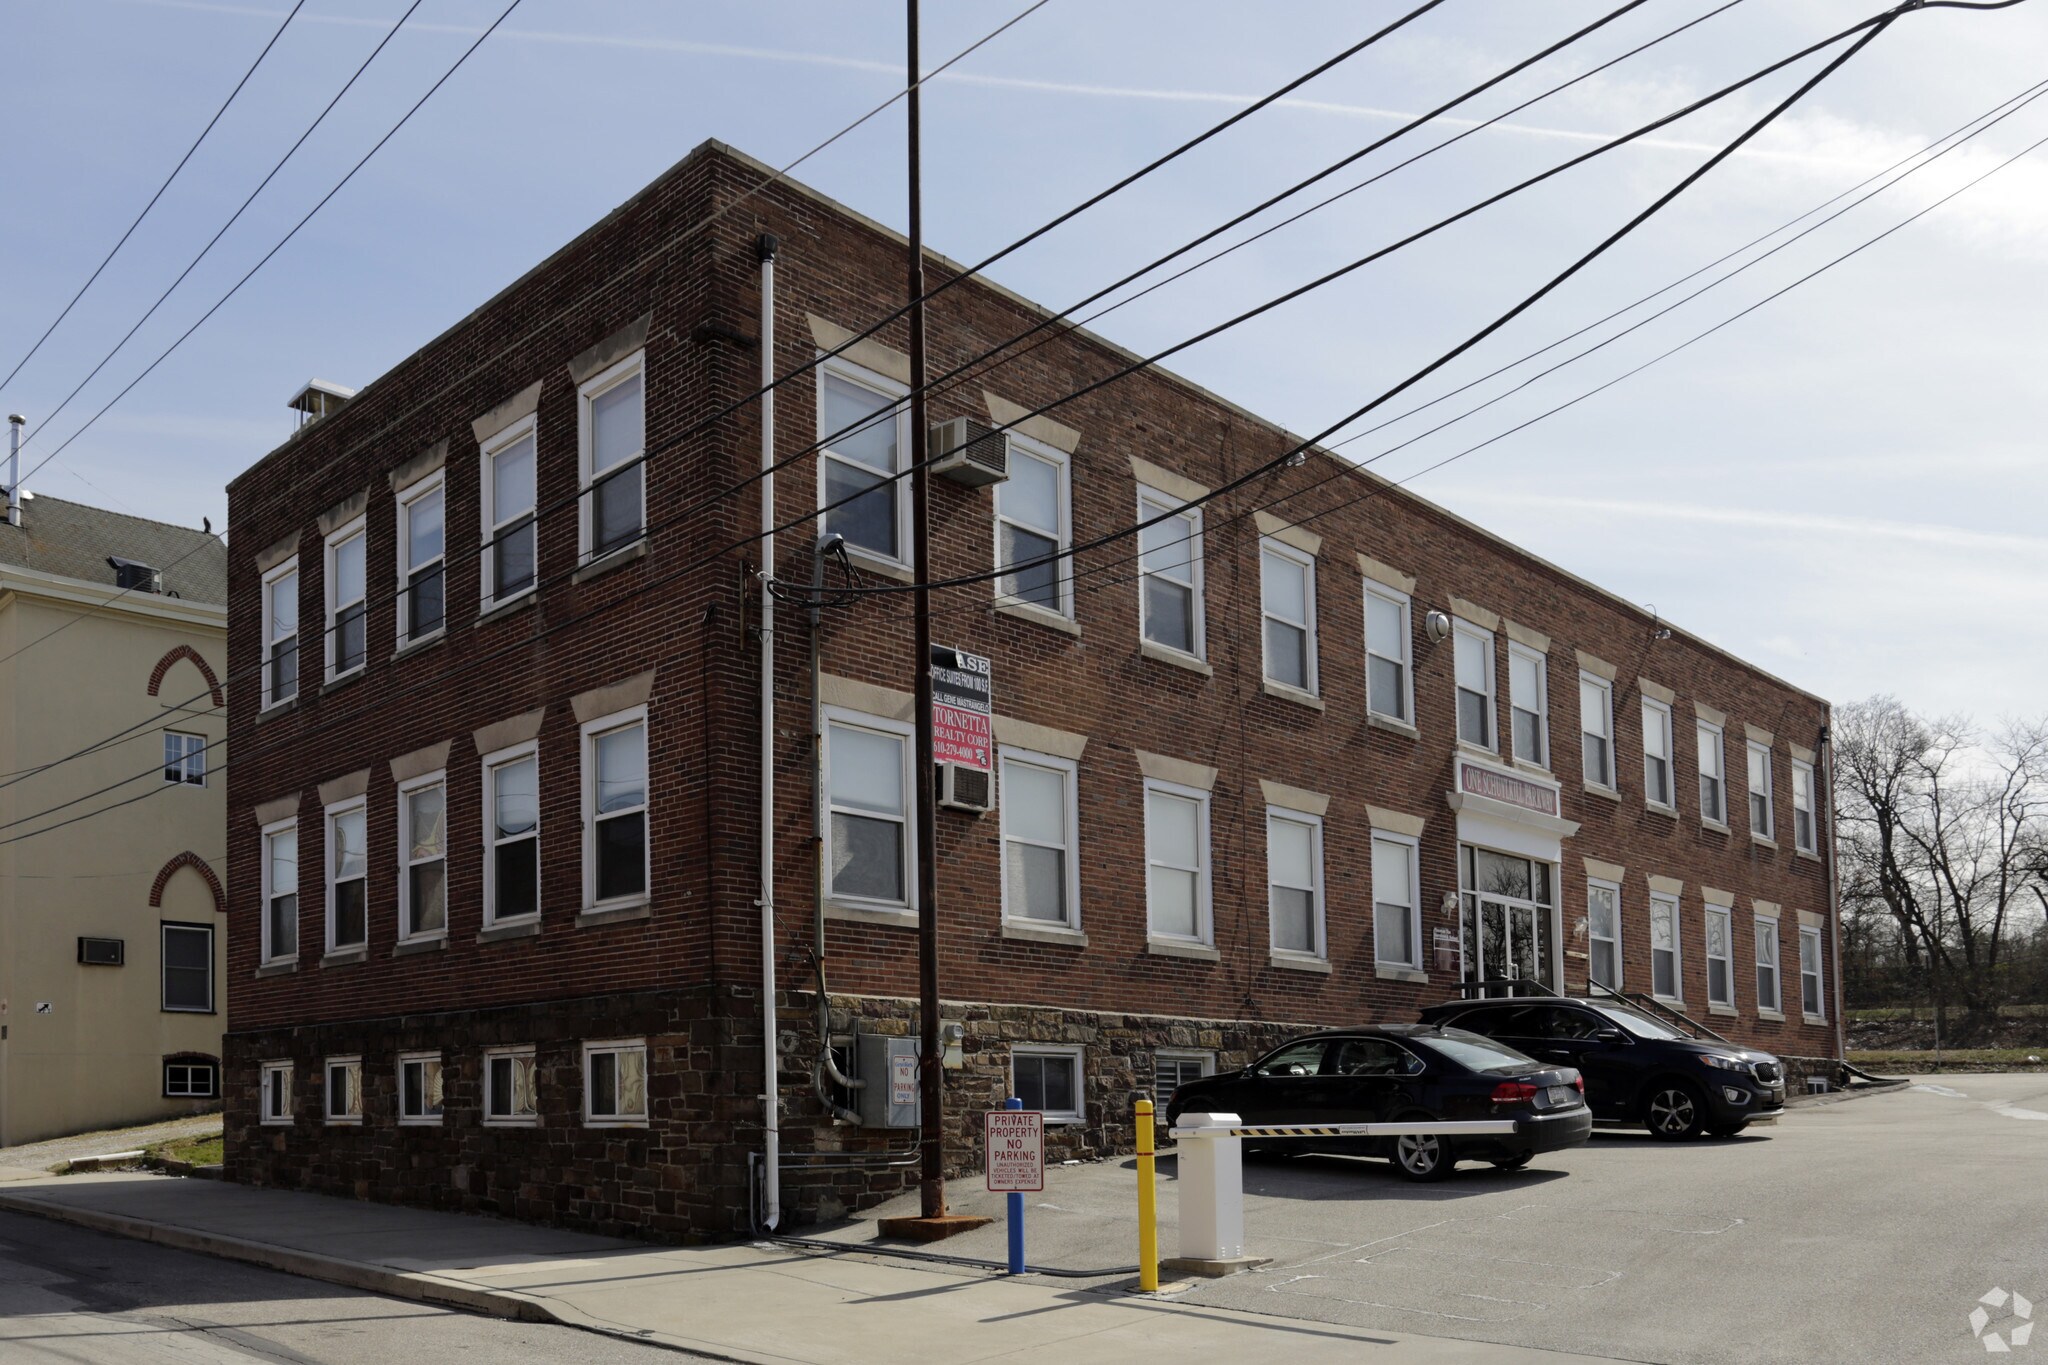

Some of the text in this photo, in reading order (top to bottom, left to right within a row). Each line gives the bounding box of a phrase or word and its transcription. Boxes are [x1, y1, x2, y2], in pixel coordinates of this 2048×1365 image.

[931, 664, 946, 682] OFFICE
[946, 669, 961, 686] SUITES
[962, 674, 974, 689] FROM
[943, 694, 956, 705] GENE
[956, 696, 989, 712] MASTRANGELO
[933, 706, 988, 734] TORNETTA
[934, 726, 988, 748] REALTY CORP.
[933, 740, 973, 759] 610-279-4000
[1466, 767, 1554, 812] ONE SCHUYLKILL PARKWAY
[900, 1068, 908, 1076] NO
[894, 1083, 915, 1092] PARKING
[995, 1116, 1034, 1126] PRIVATE
[990, 1127, 1039, 1138] PROPERTY
[1007, 1139, 1023, 1149] NO
[994, 1150, 1036, 1161] PARKING
